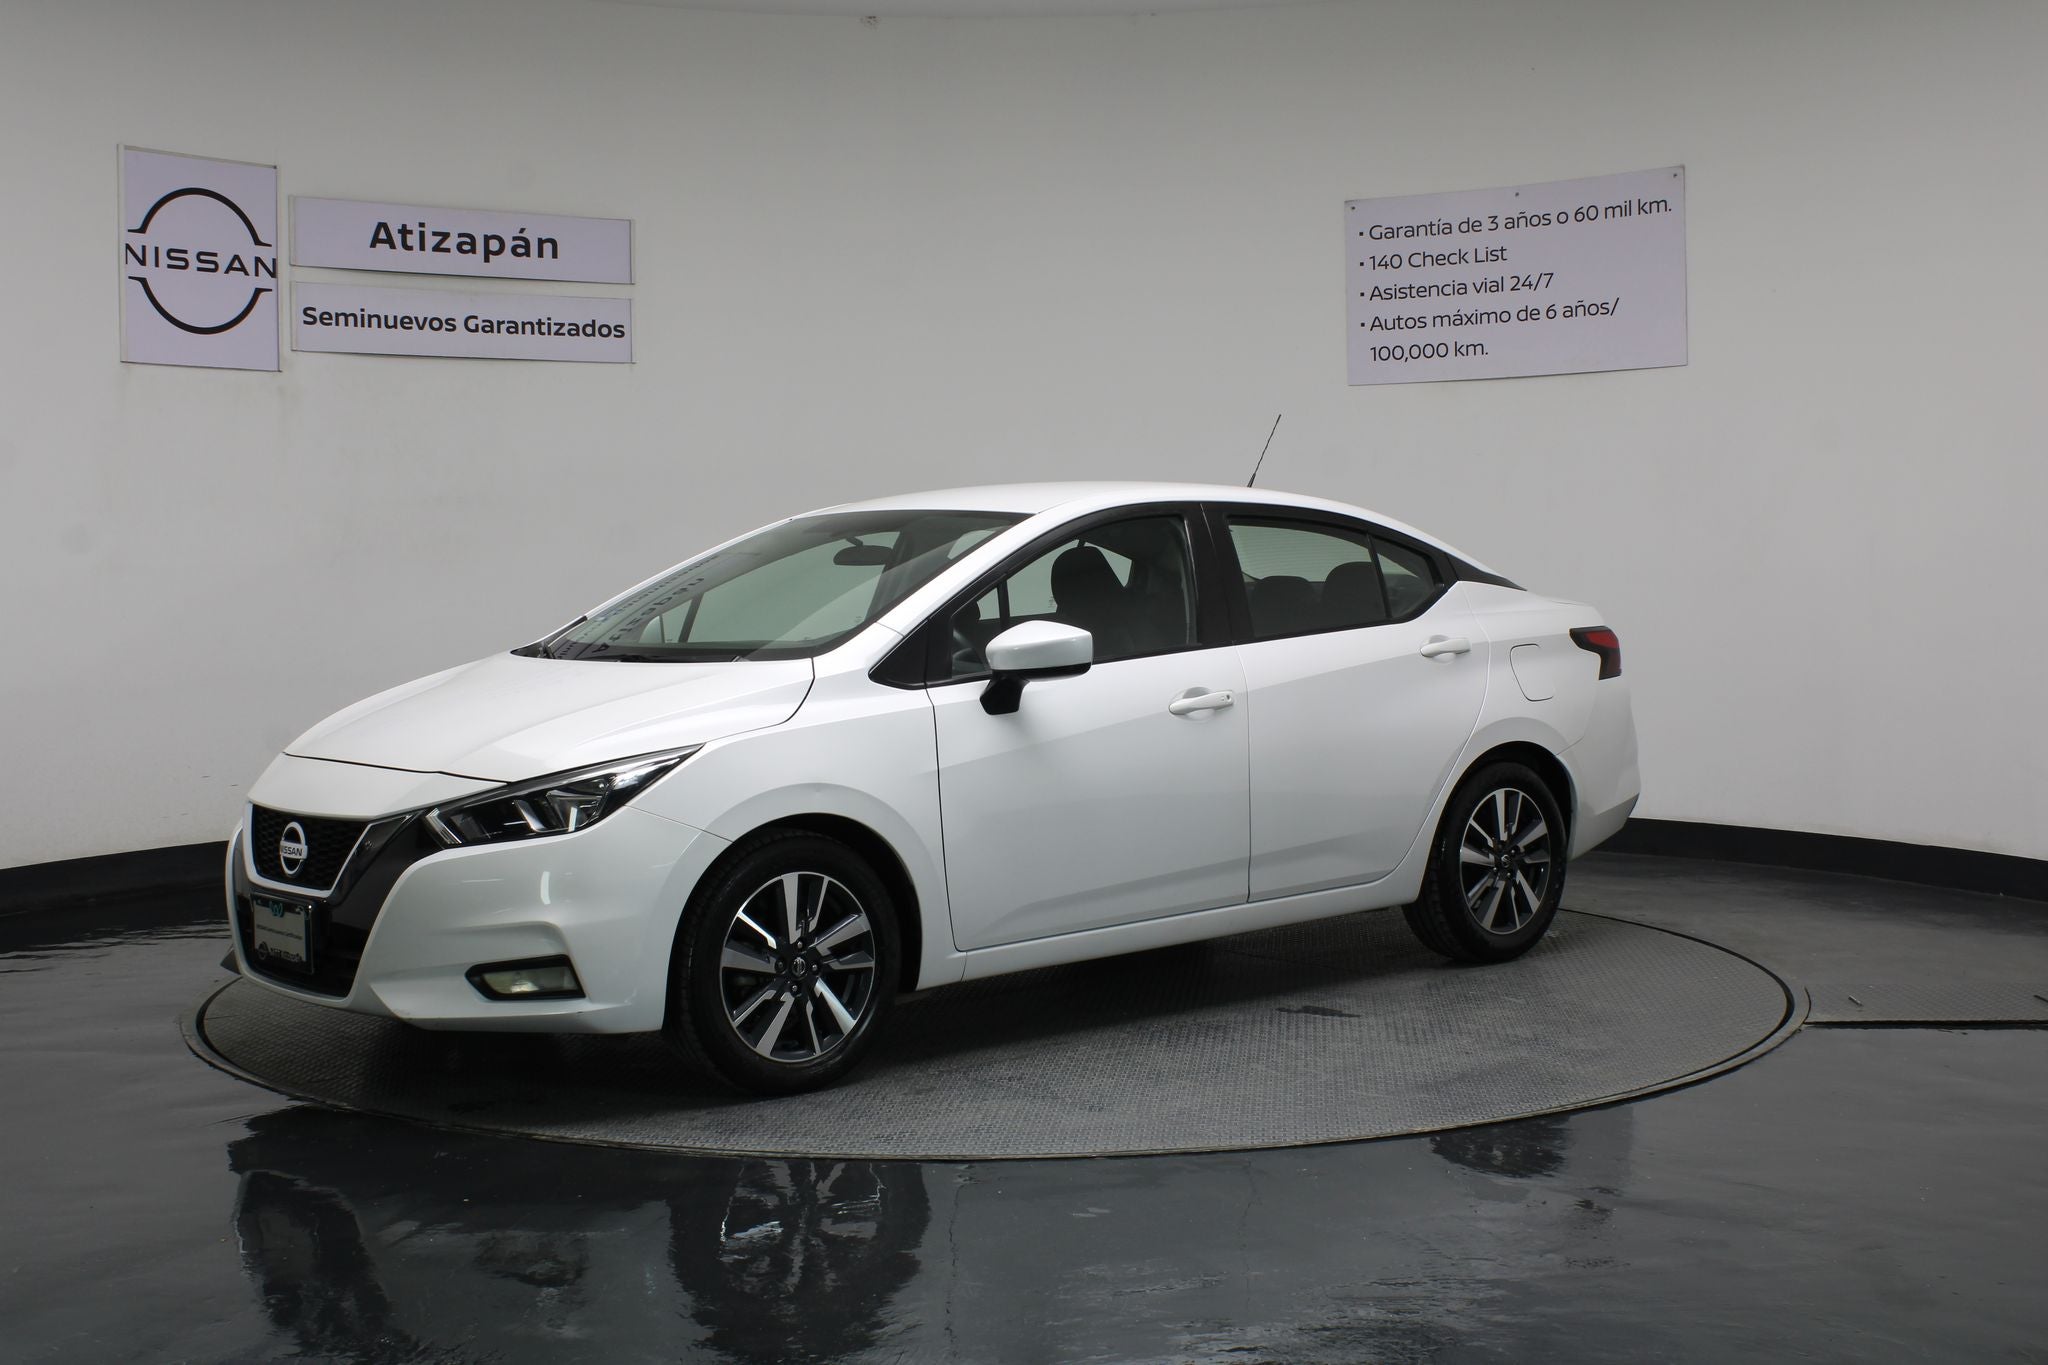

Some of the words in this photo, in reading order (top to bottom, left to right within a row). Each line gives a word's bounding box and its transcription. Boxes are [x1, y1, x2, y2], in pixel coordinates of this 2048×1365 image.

[1368, 217, 1453, 241] Garantía
[1457, 216, 1483, 234] de
[1487, 215, 1499, 232] 3
[1504, 210, 1552, 230] años
[1556, 211, 1570, 225] o
[1573, 204, 1599, 223] 60
[1604, 199, 1633, 219] mil
[1637, 197, 1673, 216] km.
[369, 221, 559, 264] Atizapán
[1368, 253, 1403, 271] 140
[1407, 248, 1469, 270] Check
[1474, 245, 1508, 263] List
[125, 242, 278, 279] NISSAN
[1369, 279, 1468, 302] Asistencia
[1472, 275, 1505, 295] vial
[1509, 272, 1555, 292] 24/7
[302, 306, 457, 334] Seminuevos
[463, 314, 626, 340] Garantizados
[1369, 314, 1428, 333] Autos
[1432, 308, 1512, 328] máximo
[1516, 304, 1541, 323] de
[1545, 303, 1558, 320] 6
[1562, 296, 1620, 320] años/
[1369, 342, 1450, 363] 100,000
[1453, 340, 1490, 358] km.
